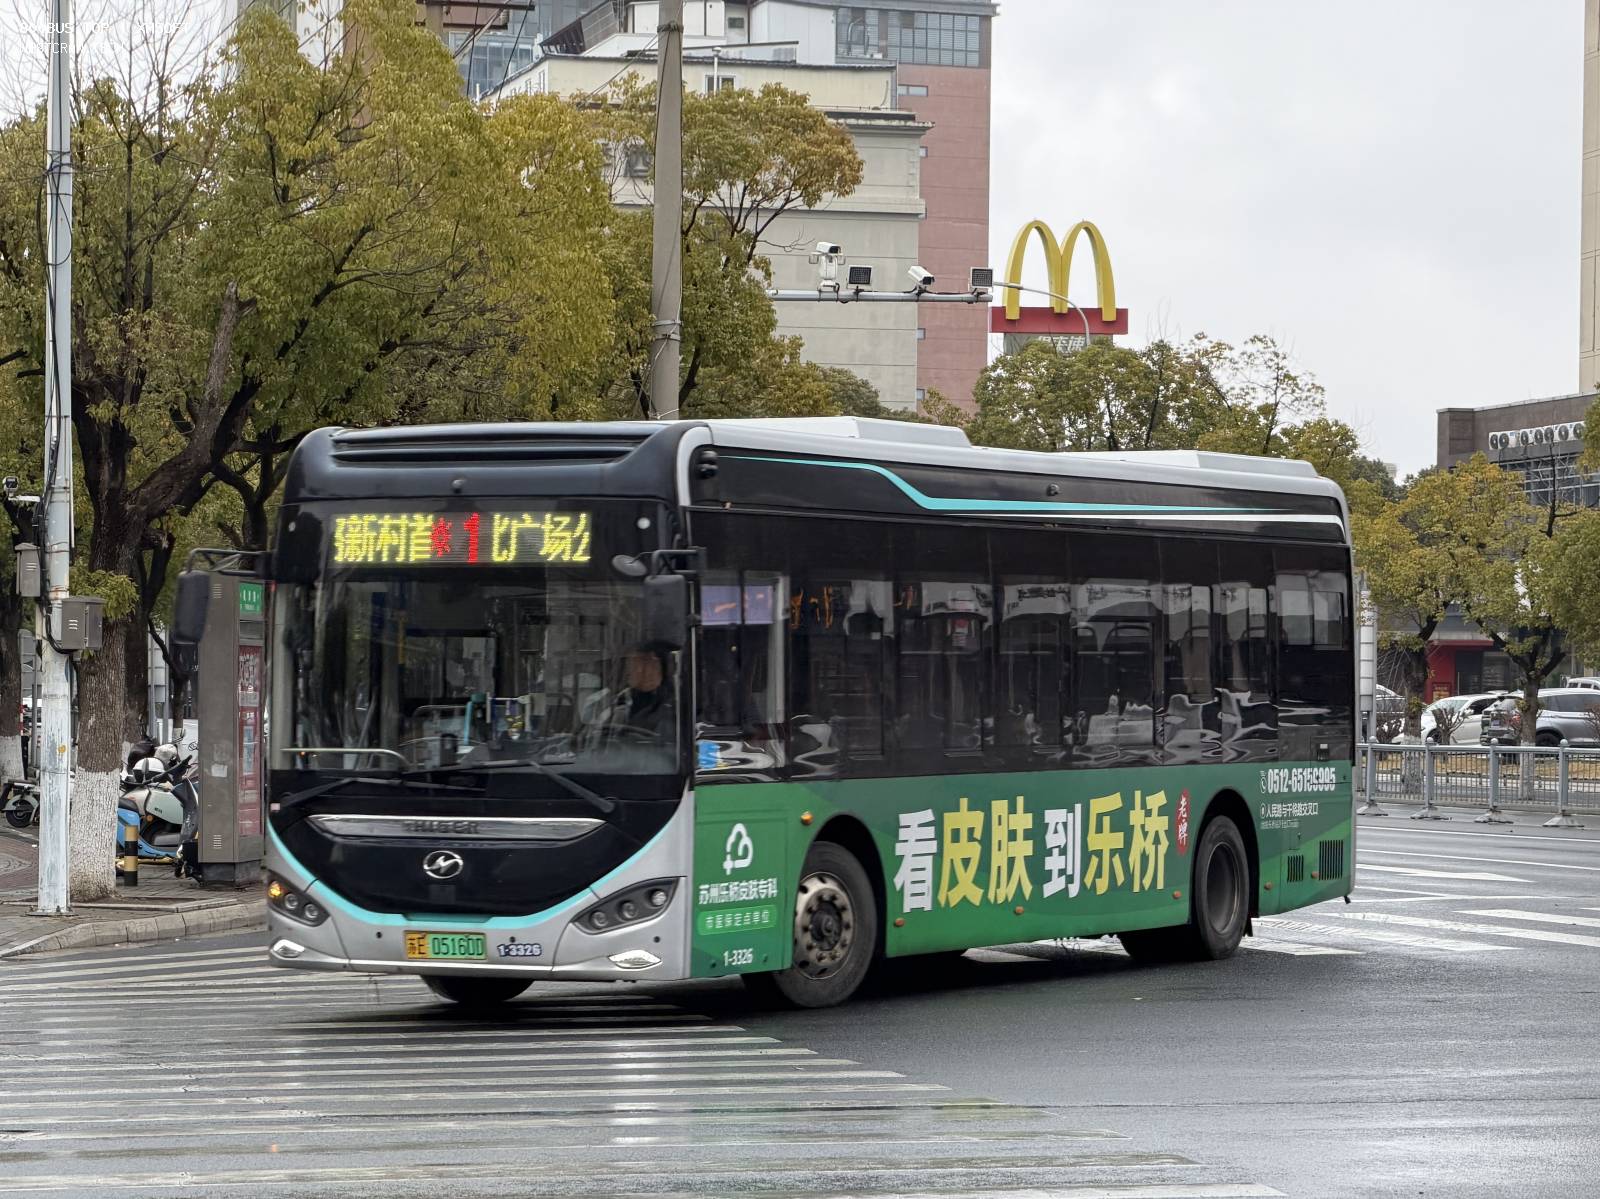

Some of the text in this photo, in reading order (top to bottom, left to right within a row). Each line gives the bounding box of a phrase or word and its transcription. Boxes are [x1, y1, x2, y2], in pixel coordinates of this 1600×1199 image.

[463, 511, 481, 564] 1
[892, 789, 1169, 914] 看皮肤到乐桥
[497, 943, 543, 957] 1-3326
[723, 947, 754, 967] 1-3326
